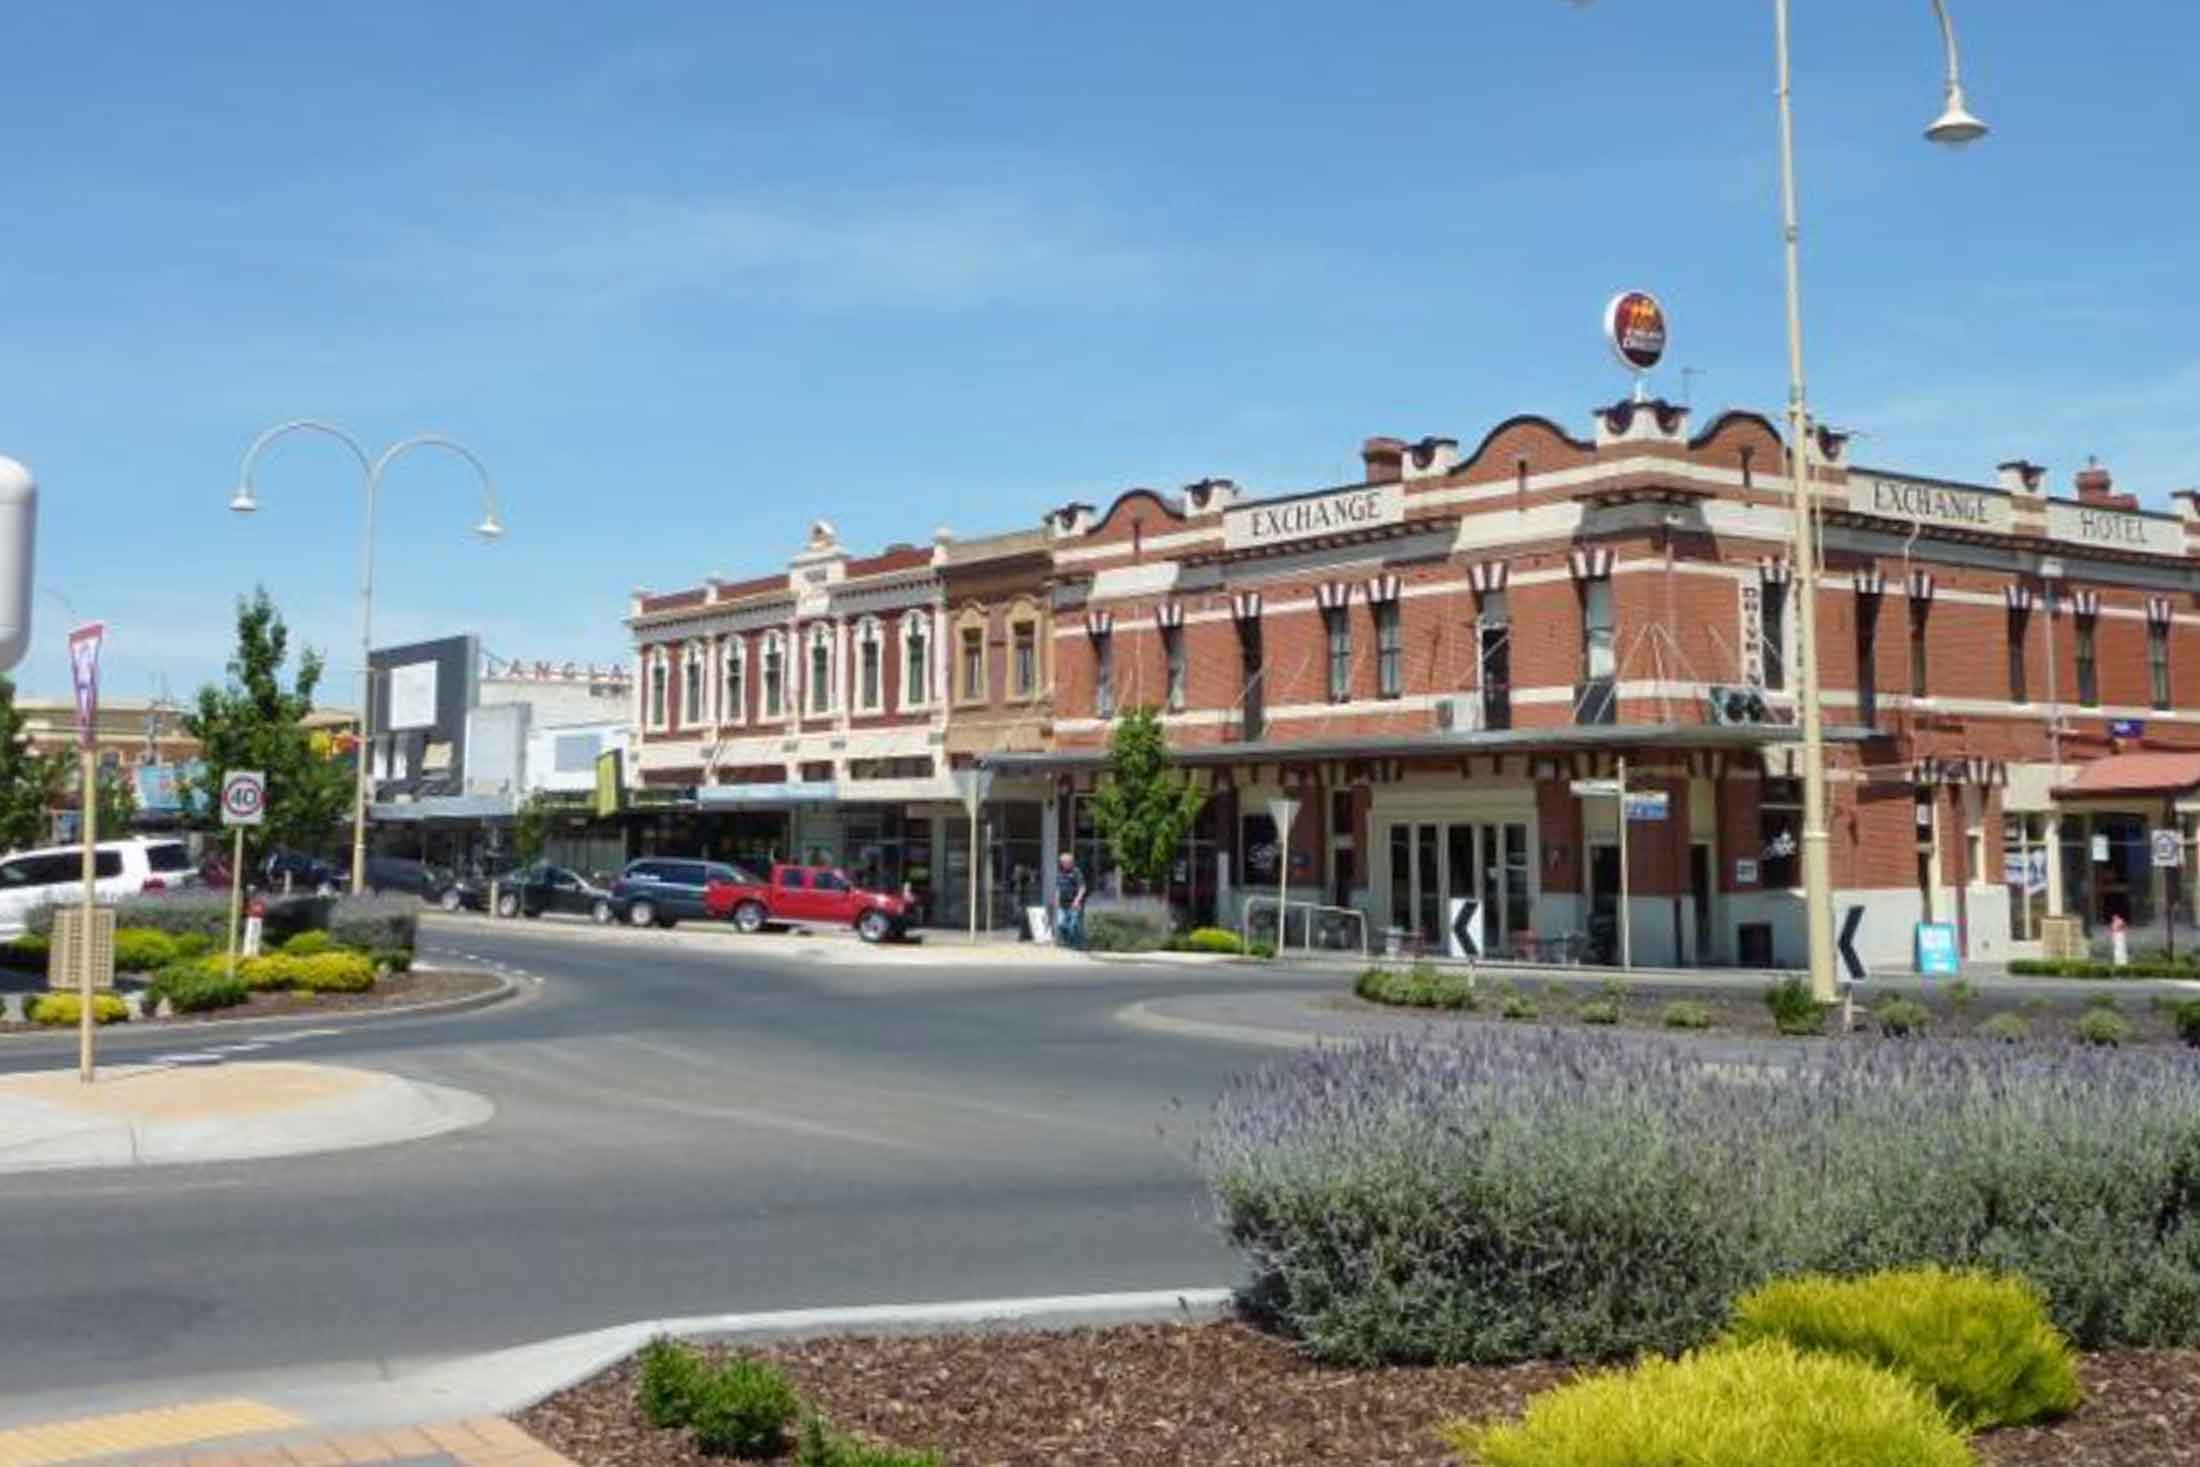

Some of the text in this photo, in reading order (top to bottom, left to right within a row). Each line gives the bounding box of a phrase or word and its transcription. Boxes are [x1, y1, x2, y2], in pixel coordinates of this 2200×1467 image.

[1251, 491, 1382, 537] EXCHANGE
[1873, 480, 2148, 544] EXCHANGE HOTEL
[231, 788, 257, 806] 40
